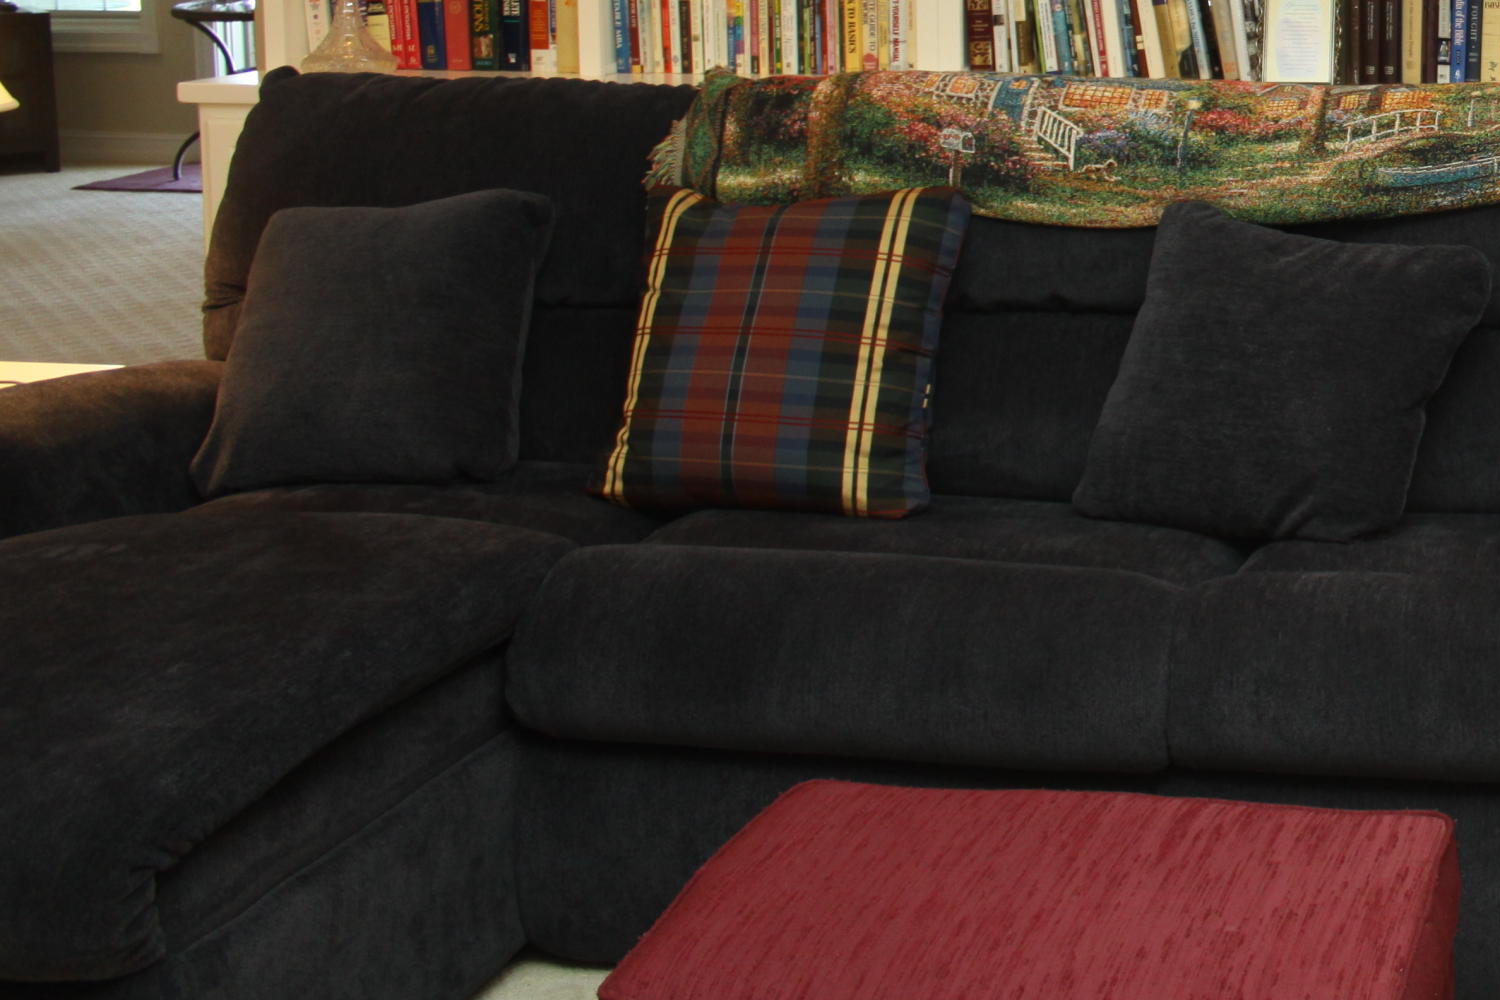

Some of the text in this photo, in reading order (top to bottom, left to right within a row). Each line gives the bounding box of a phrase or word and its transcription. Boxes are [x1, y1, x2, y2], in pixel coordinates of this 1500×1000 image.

[848, 7, 858, 19] TO
[1470, 4, 1480, 41] FOUGHT
[848, 21, 859, 54] BASICS
[1455, 29, 1465, 46] Bible
